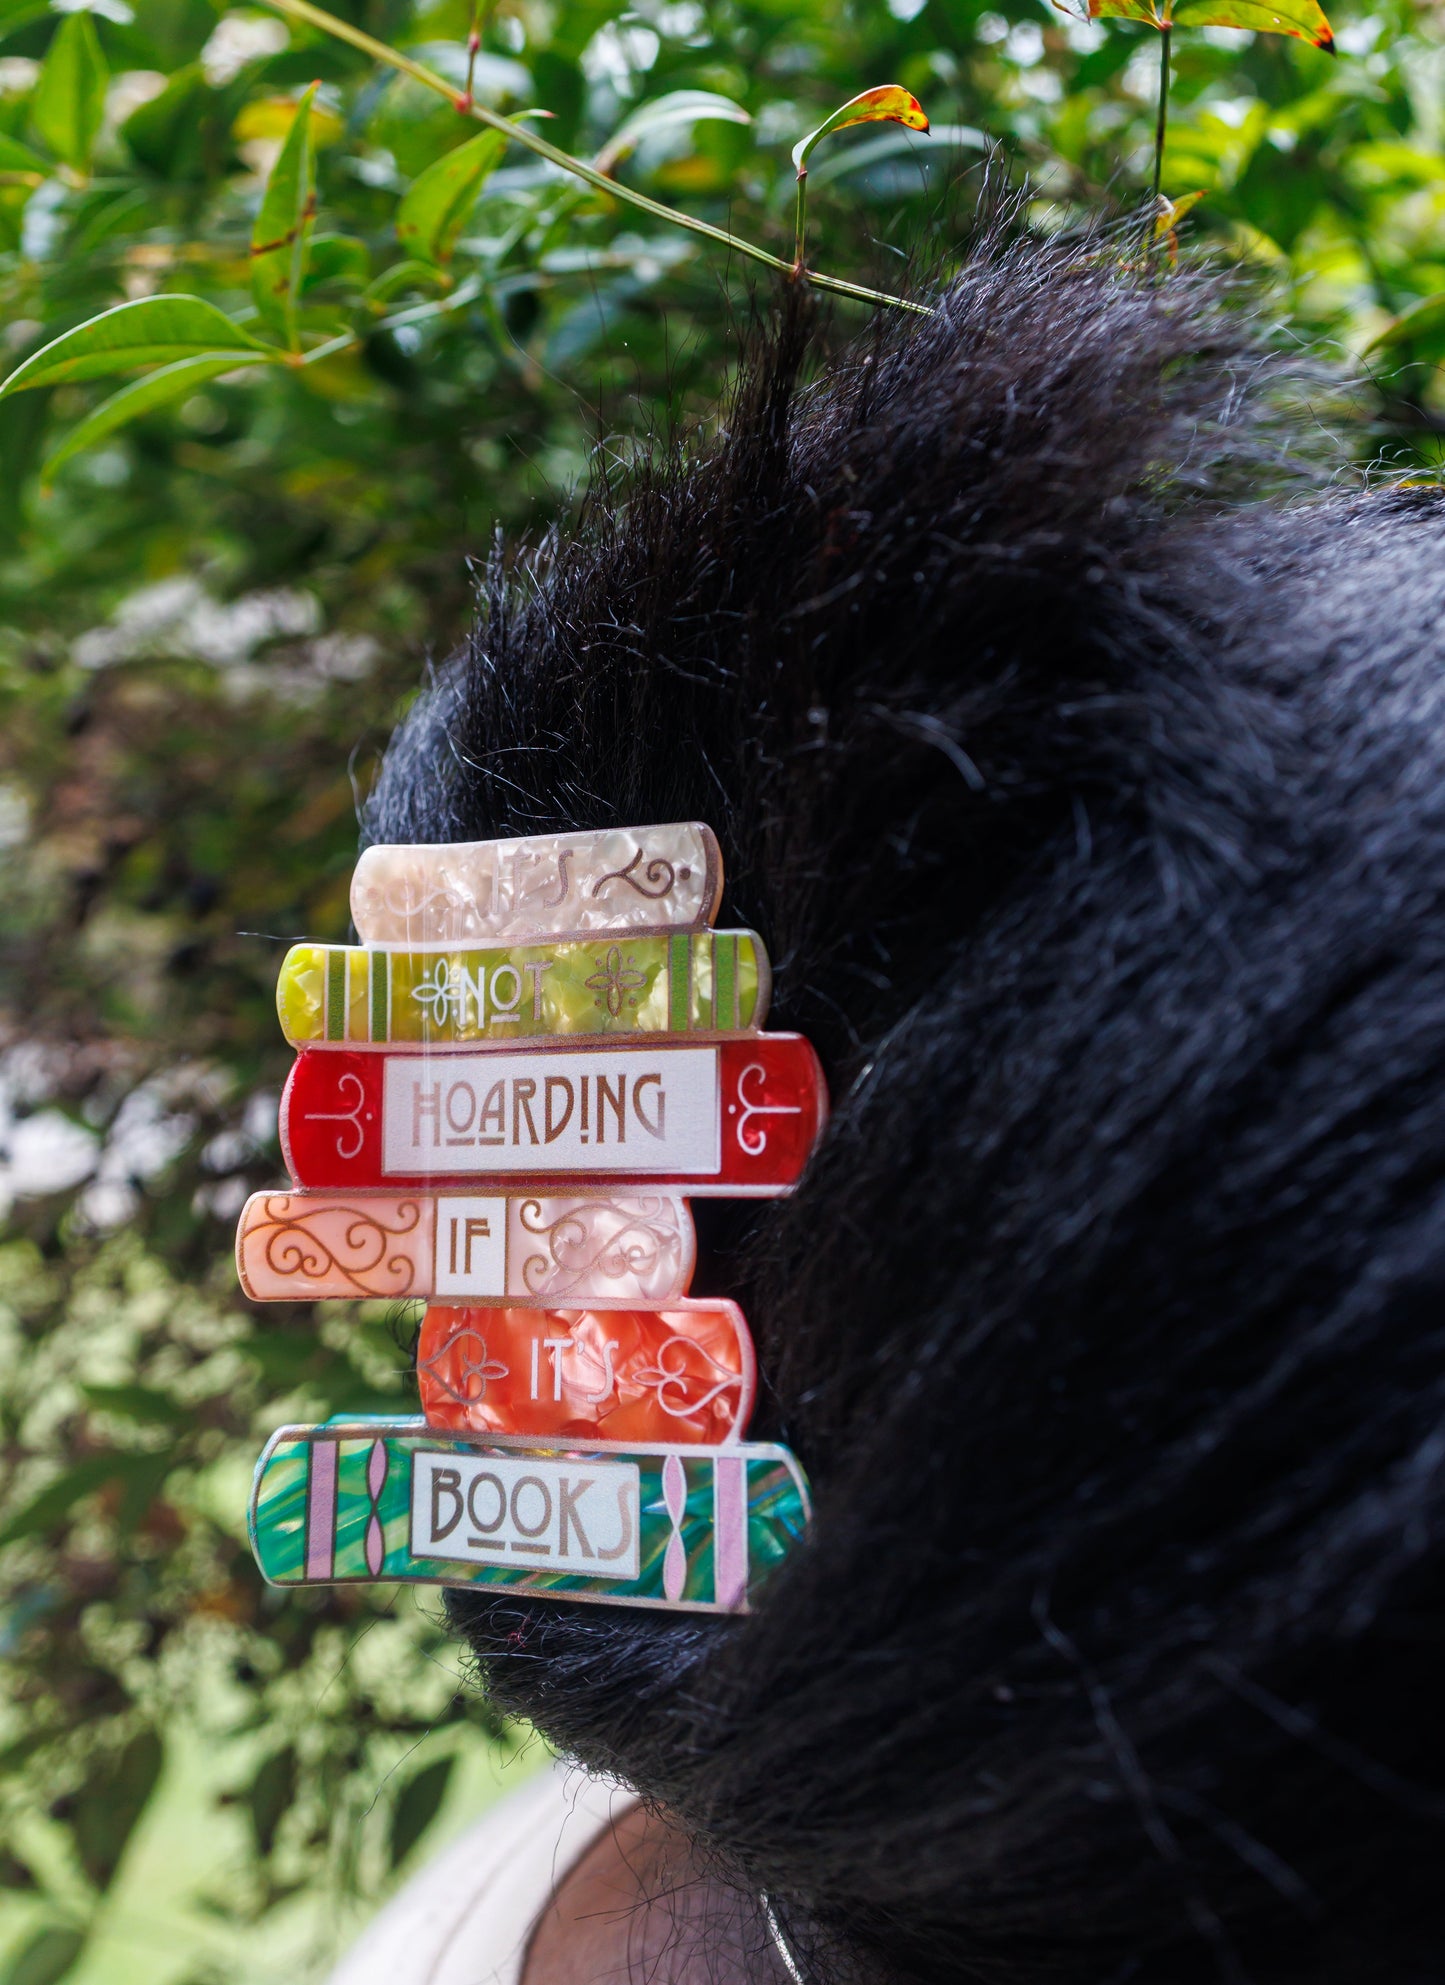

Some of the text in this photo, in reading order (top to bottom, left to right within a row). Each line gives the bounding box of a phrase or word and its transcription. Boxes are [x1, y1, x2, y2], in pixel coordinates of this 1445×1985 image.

[458, 959, 554, 1030] NOT
[411, 1072, 667, 1148] HOARDING
[448, 1216, 491, 1276] IF
[529, 1338, 620, 1402] IT'S
[428, 1466, 634, 1562] BOOKS
